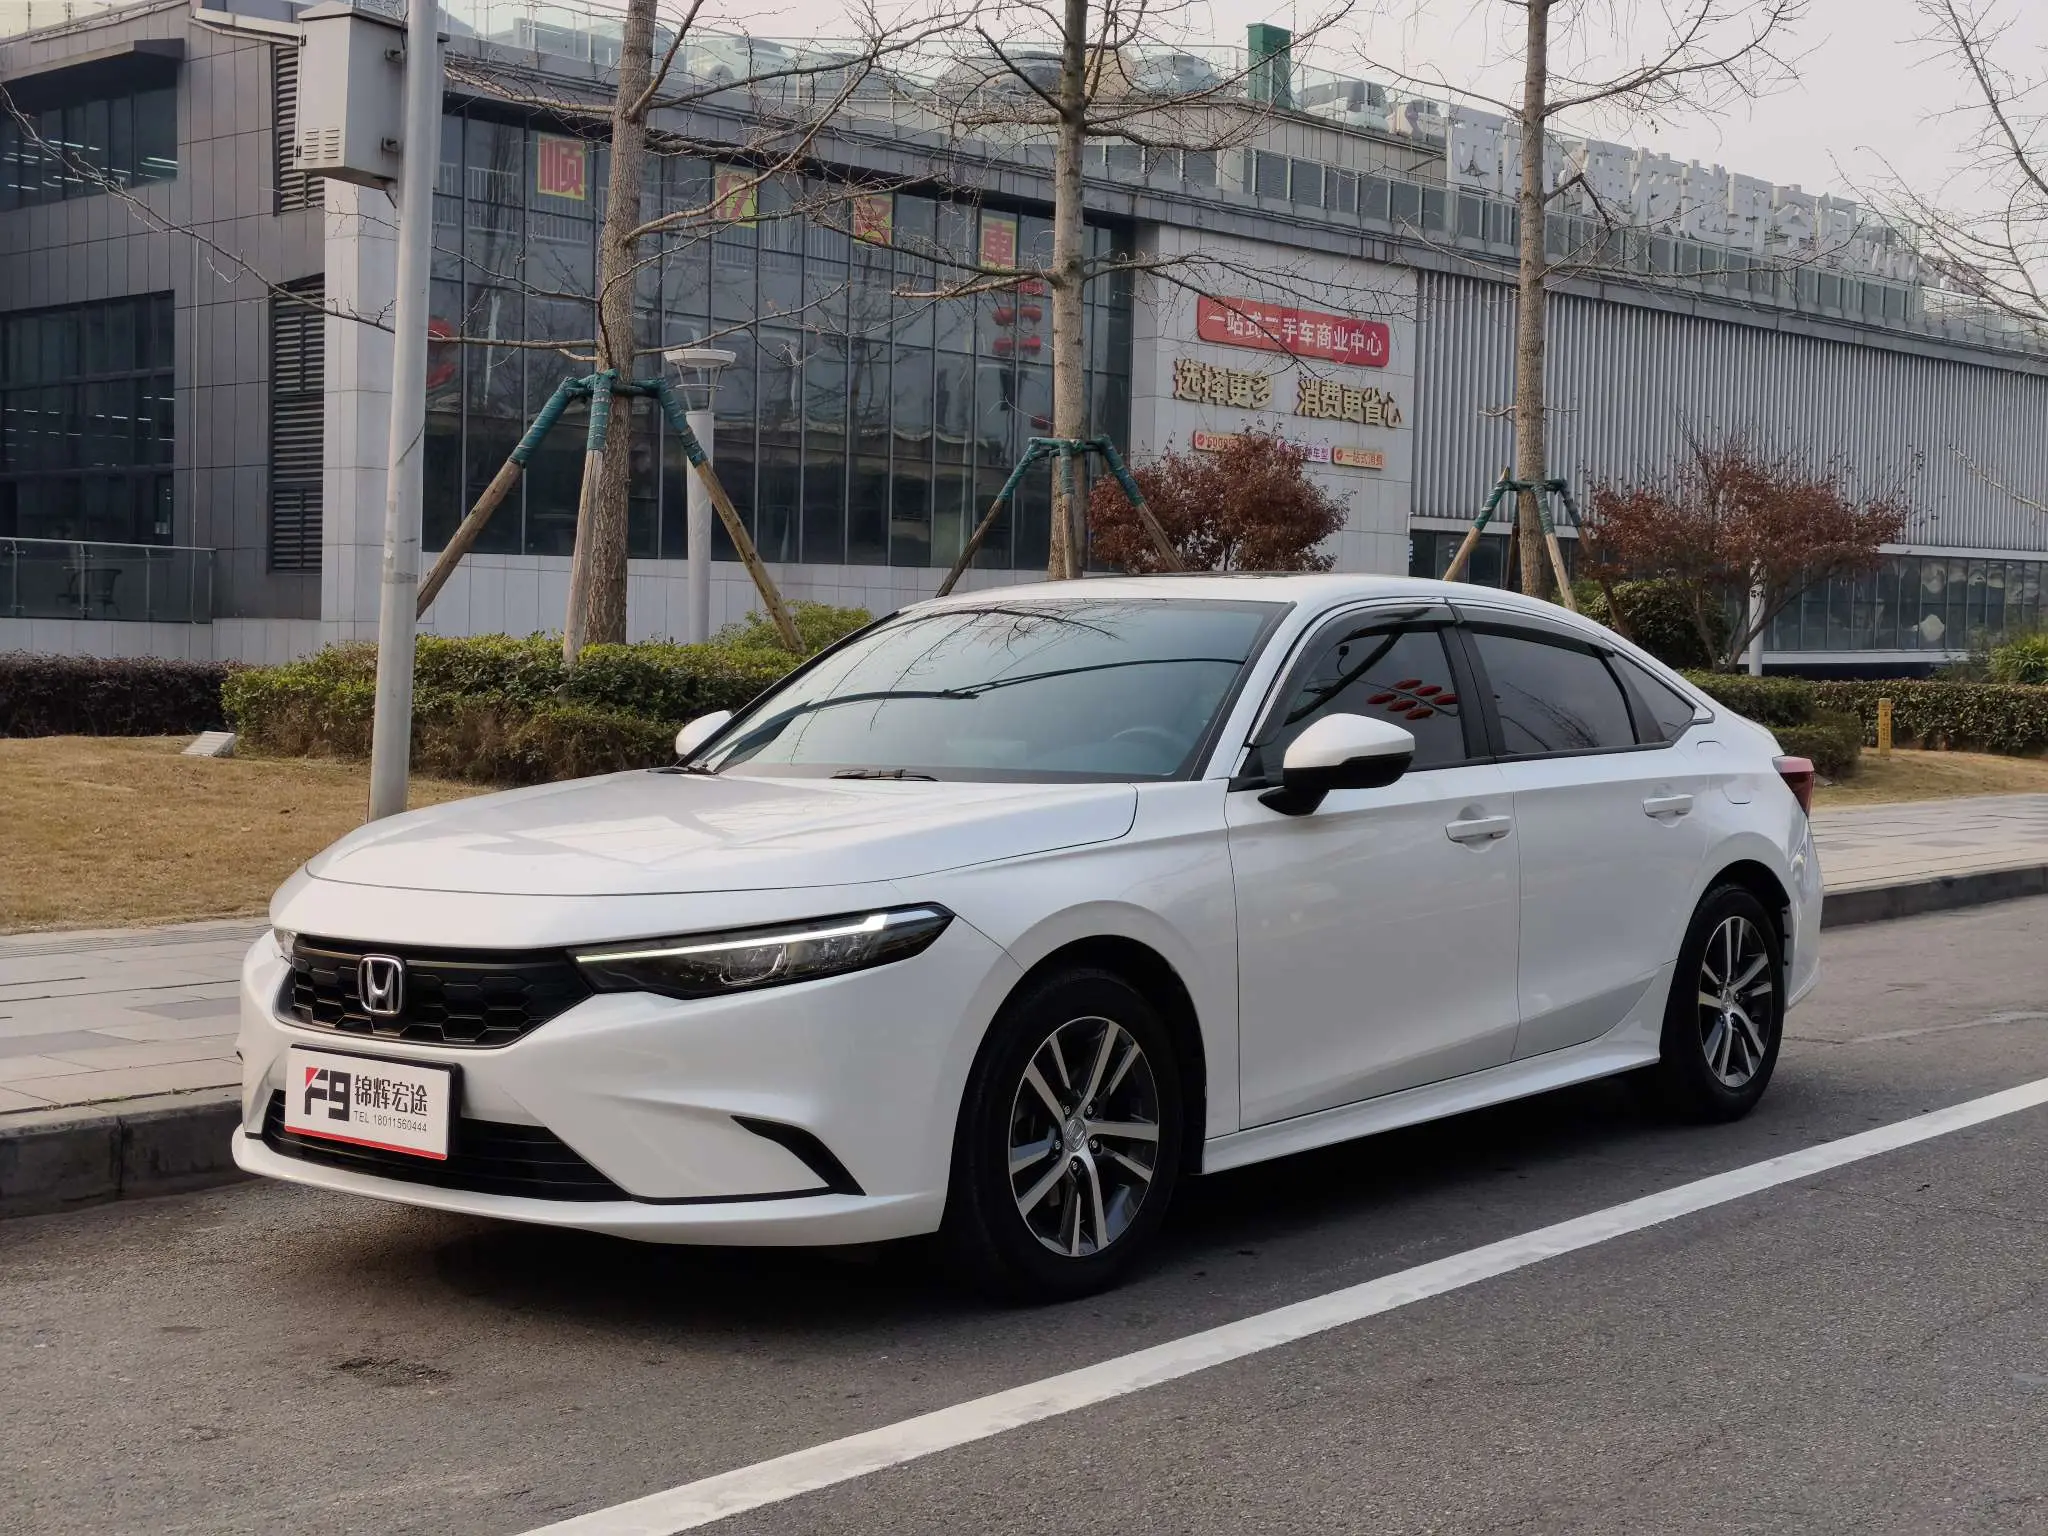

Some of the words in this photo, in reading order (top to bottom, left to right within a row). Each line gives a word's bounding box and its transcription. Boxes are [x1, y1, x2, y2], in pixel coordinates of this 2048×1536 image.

[539, 137, 584, 196] 顺
[1208, 309, 1383, 357] 一站式二手车商业中心
[1174, 358, 1273, 409] 选择更多
[1295, 377, 1402, 428] 消费更省心
[355, 1074, 428, 1116] 锦辉宏途
[353, 1110, 369, 1123] TEL
[374, 1114, 427, 1132] 18011560444
